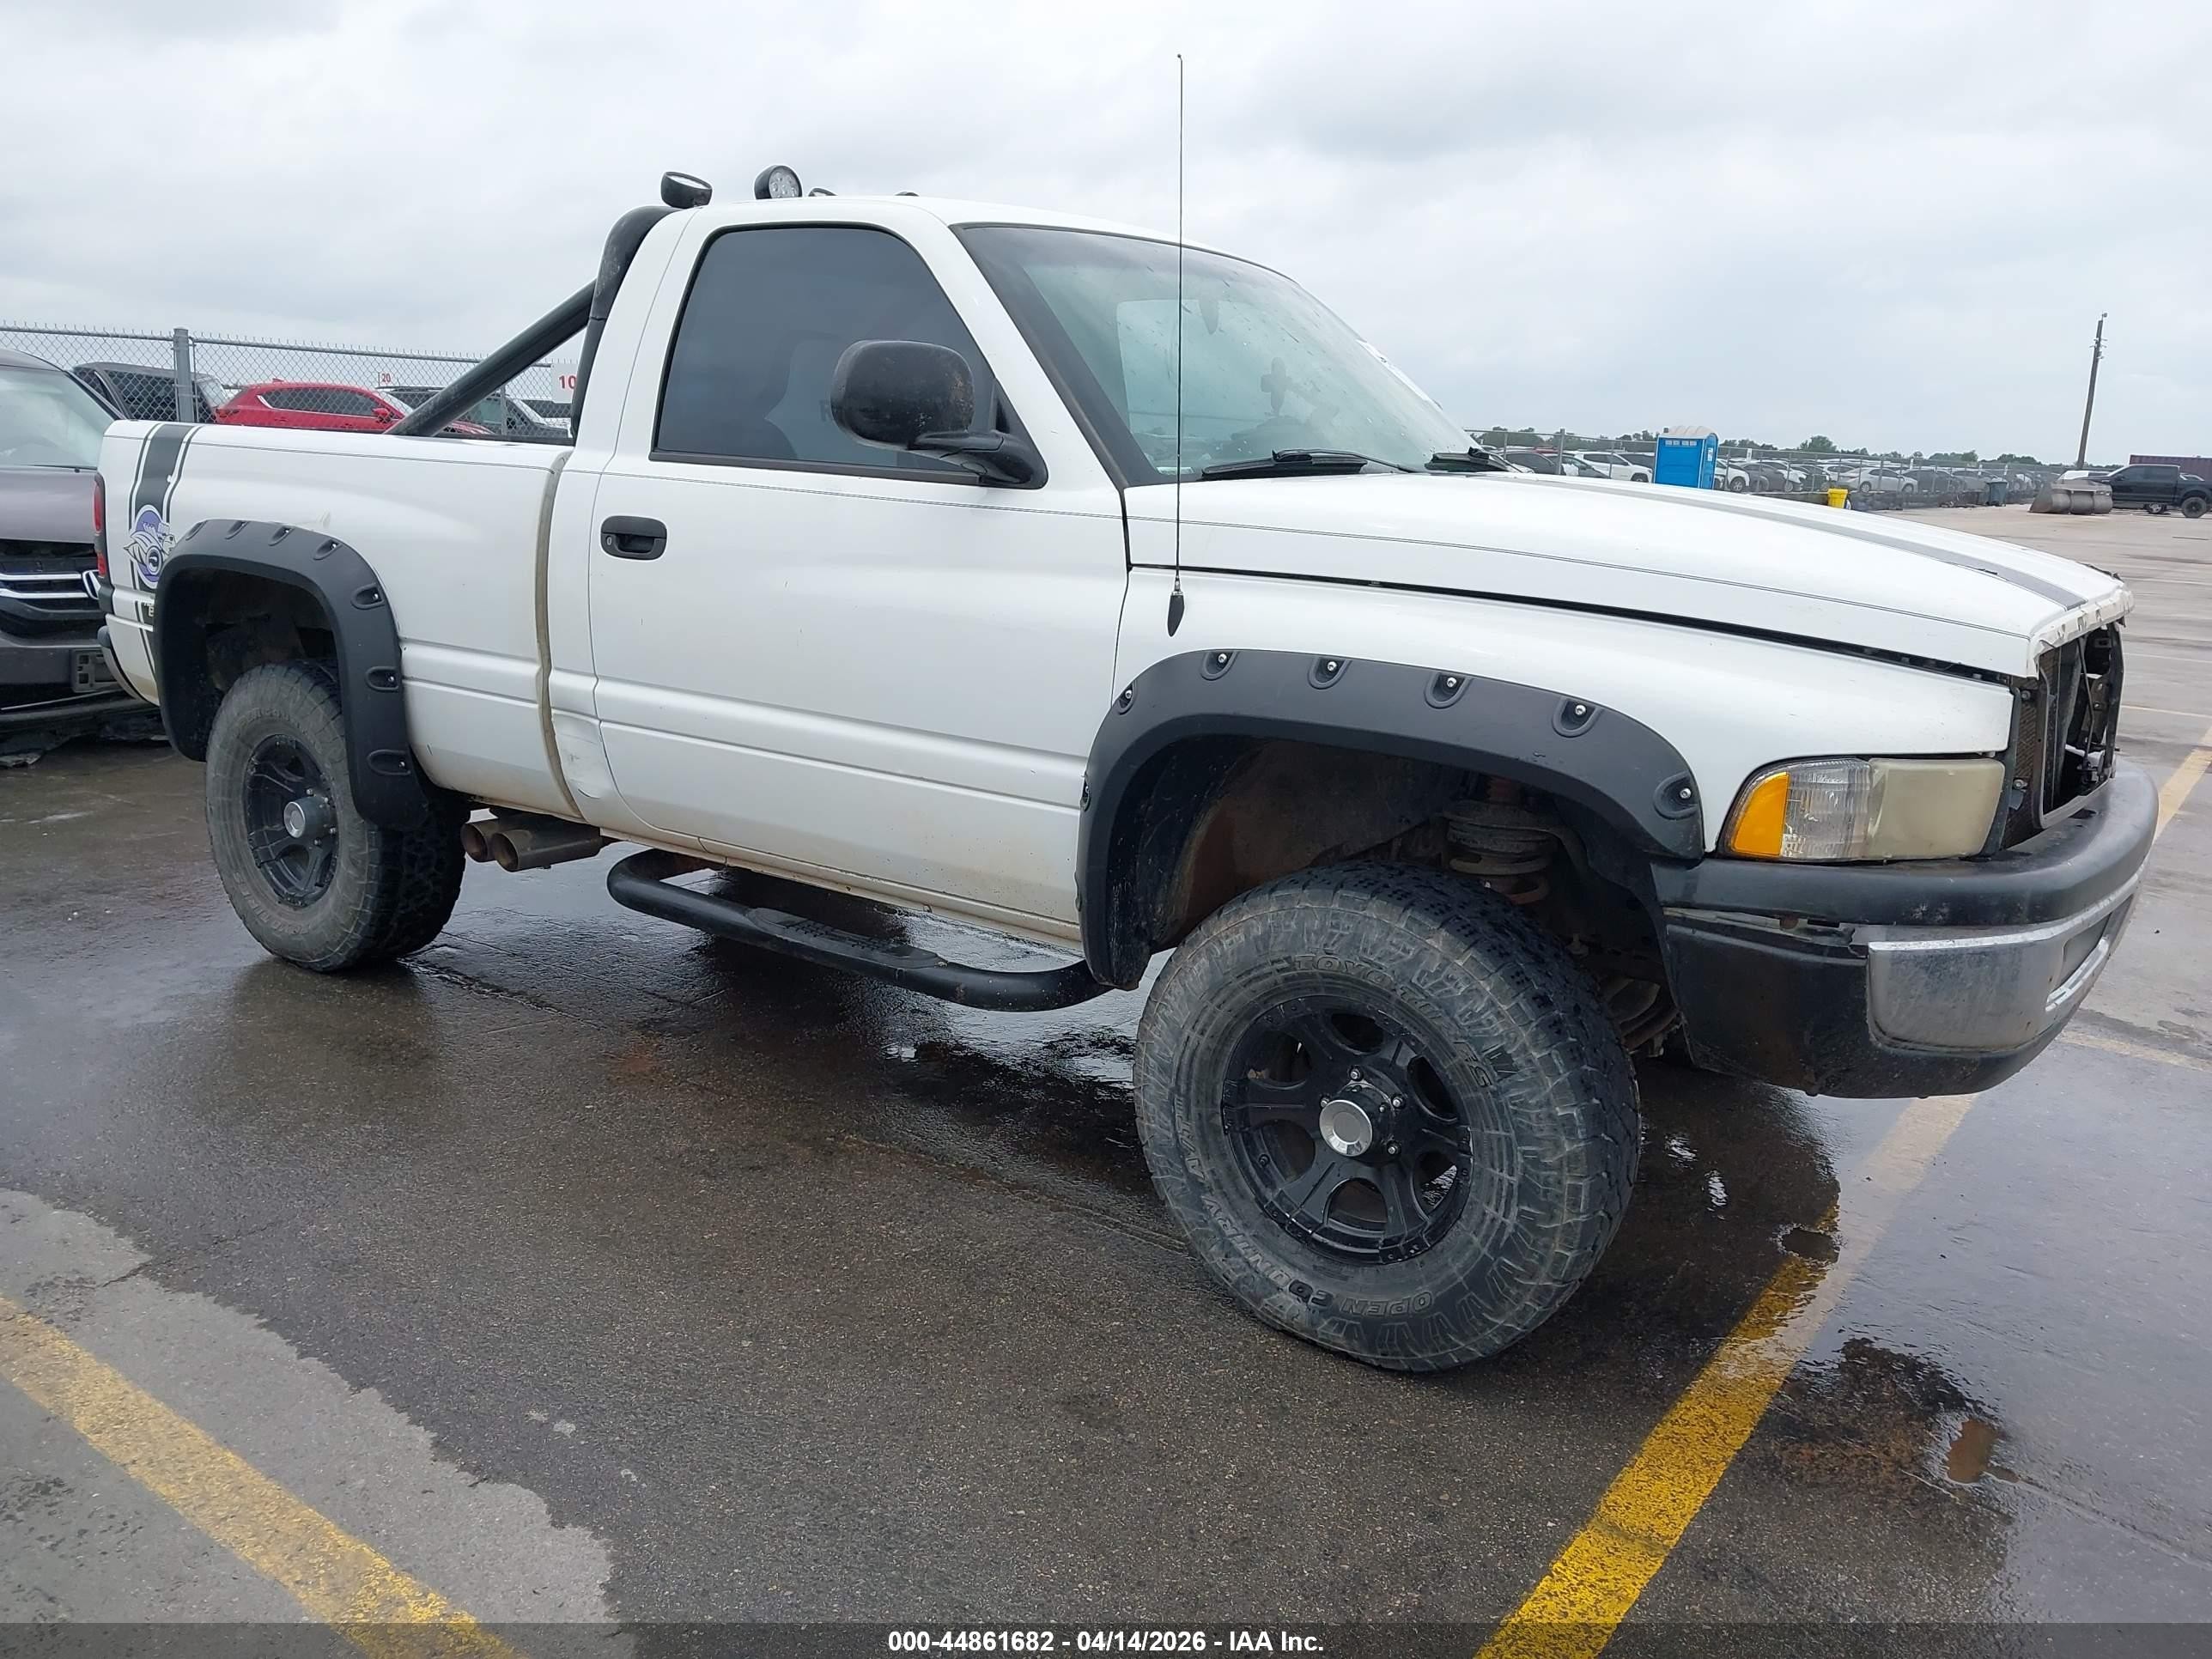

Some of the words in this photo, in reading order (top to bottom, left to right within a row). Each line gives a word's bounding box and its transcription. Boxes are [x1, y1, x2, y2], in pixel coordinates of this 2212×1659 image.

[382, 373, 392, 383] 20
[1294, 954, 1395, 988] TOYO
[1202, 1195, 1334, 1307] COUNTRY
[1340, 1291, 1433, 1317] OPEN
